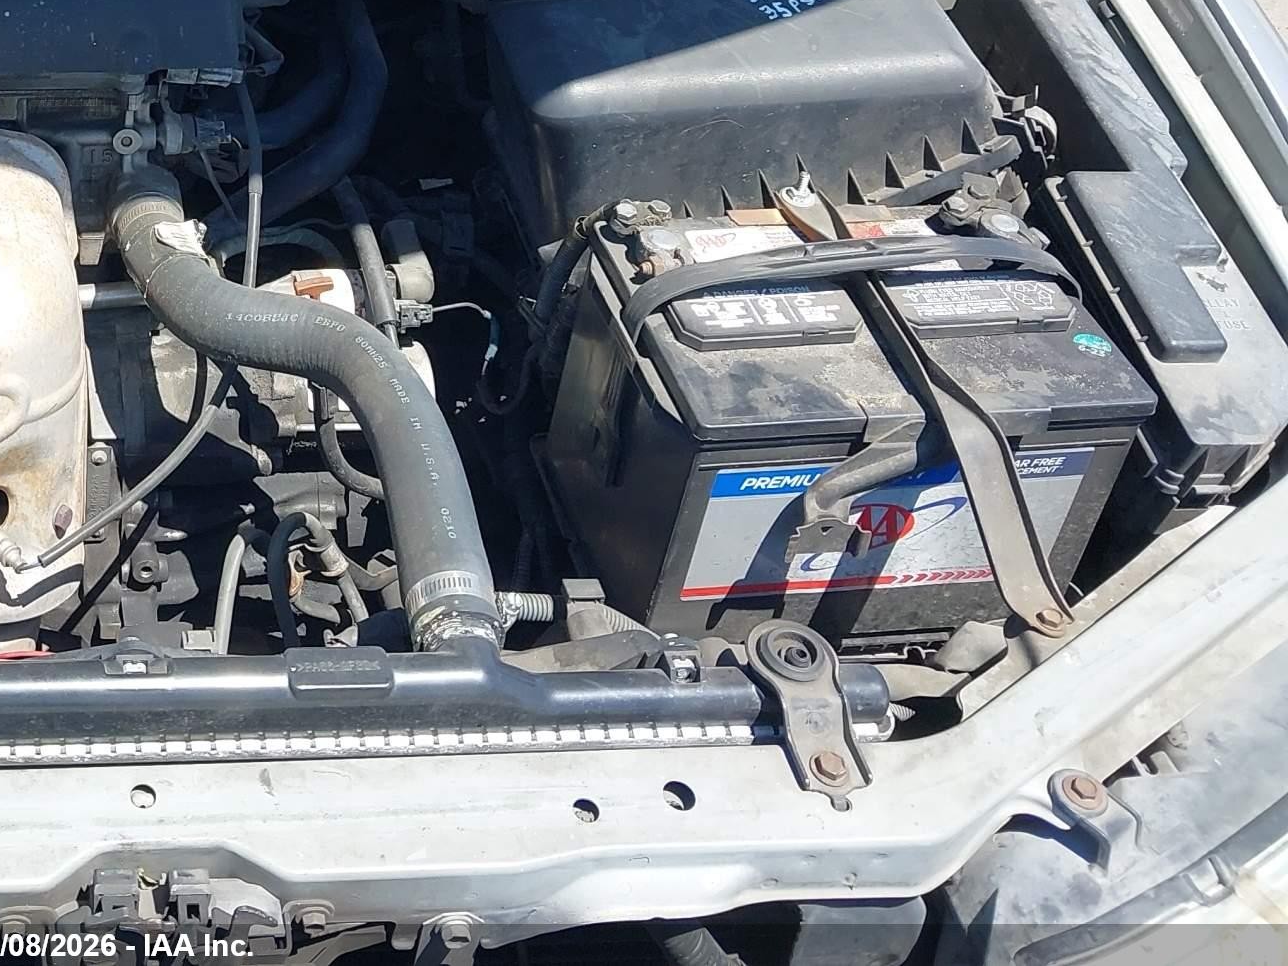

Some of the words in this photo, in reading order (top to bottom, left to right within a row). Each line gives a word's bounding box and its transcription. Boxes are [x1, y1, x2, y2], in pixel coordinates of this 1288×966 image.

[739, 473, 822, 491] PREMIU
[1031, 456, 1067, 467] FREE
[1016, 465, 1059, 475] CEMENT
